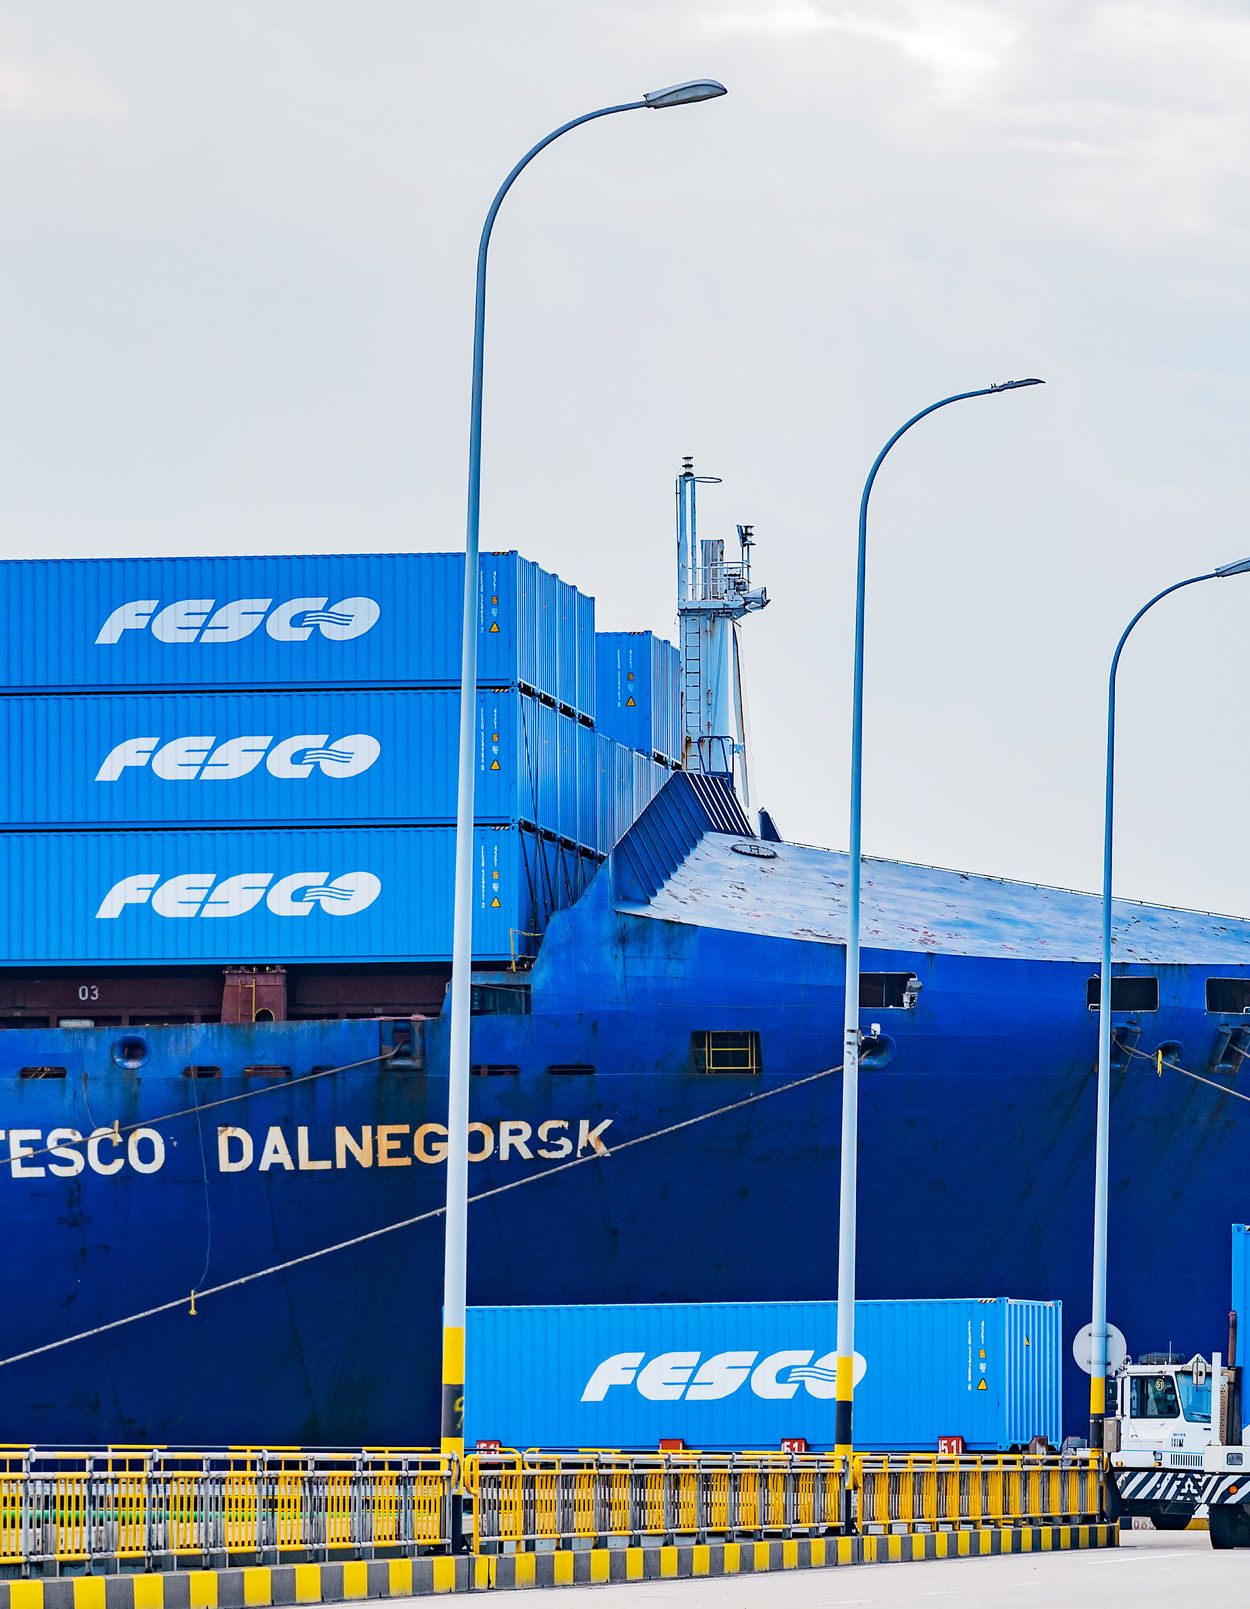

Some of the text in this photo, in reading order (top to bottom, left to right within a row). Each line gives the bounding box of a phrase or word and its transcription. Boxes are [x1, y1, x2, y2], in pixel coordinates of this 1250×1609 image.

[94, 596, 381, 644] FESCO
[94, 734, 381, 781] FESCO
[95, 871, 382, 919] FESCO
[79, 985, 99, 1000] 03
[0, 1119, 614, 1178] ESCO DALNEGORSK
[580, 1350, 867, 1402] FESCO
[941, 1439, 957, 1455] 51
